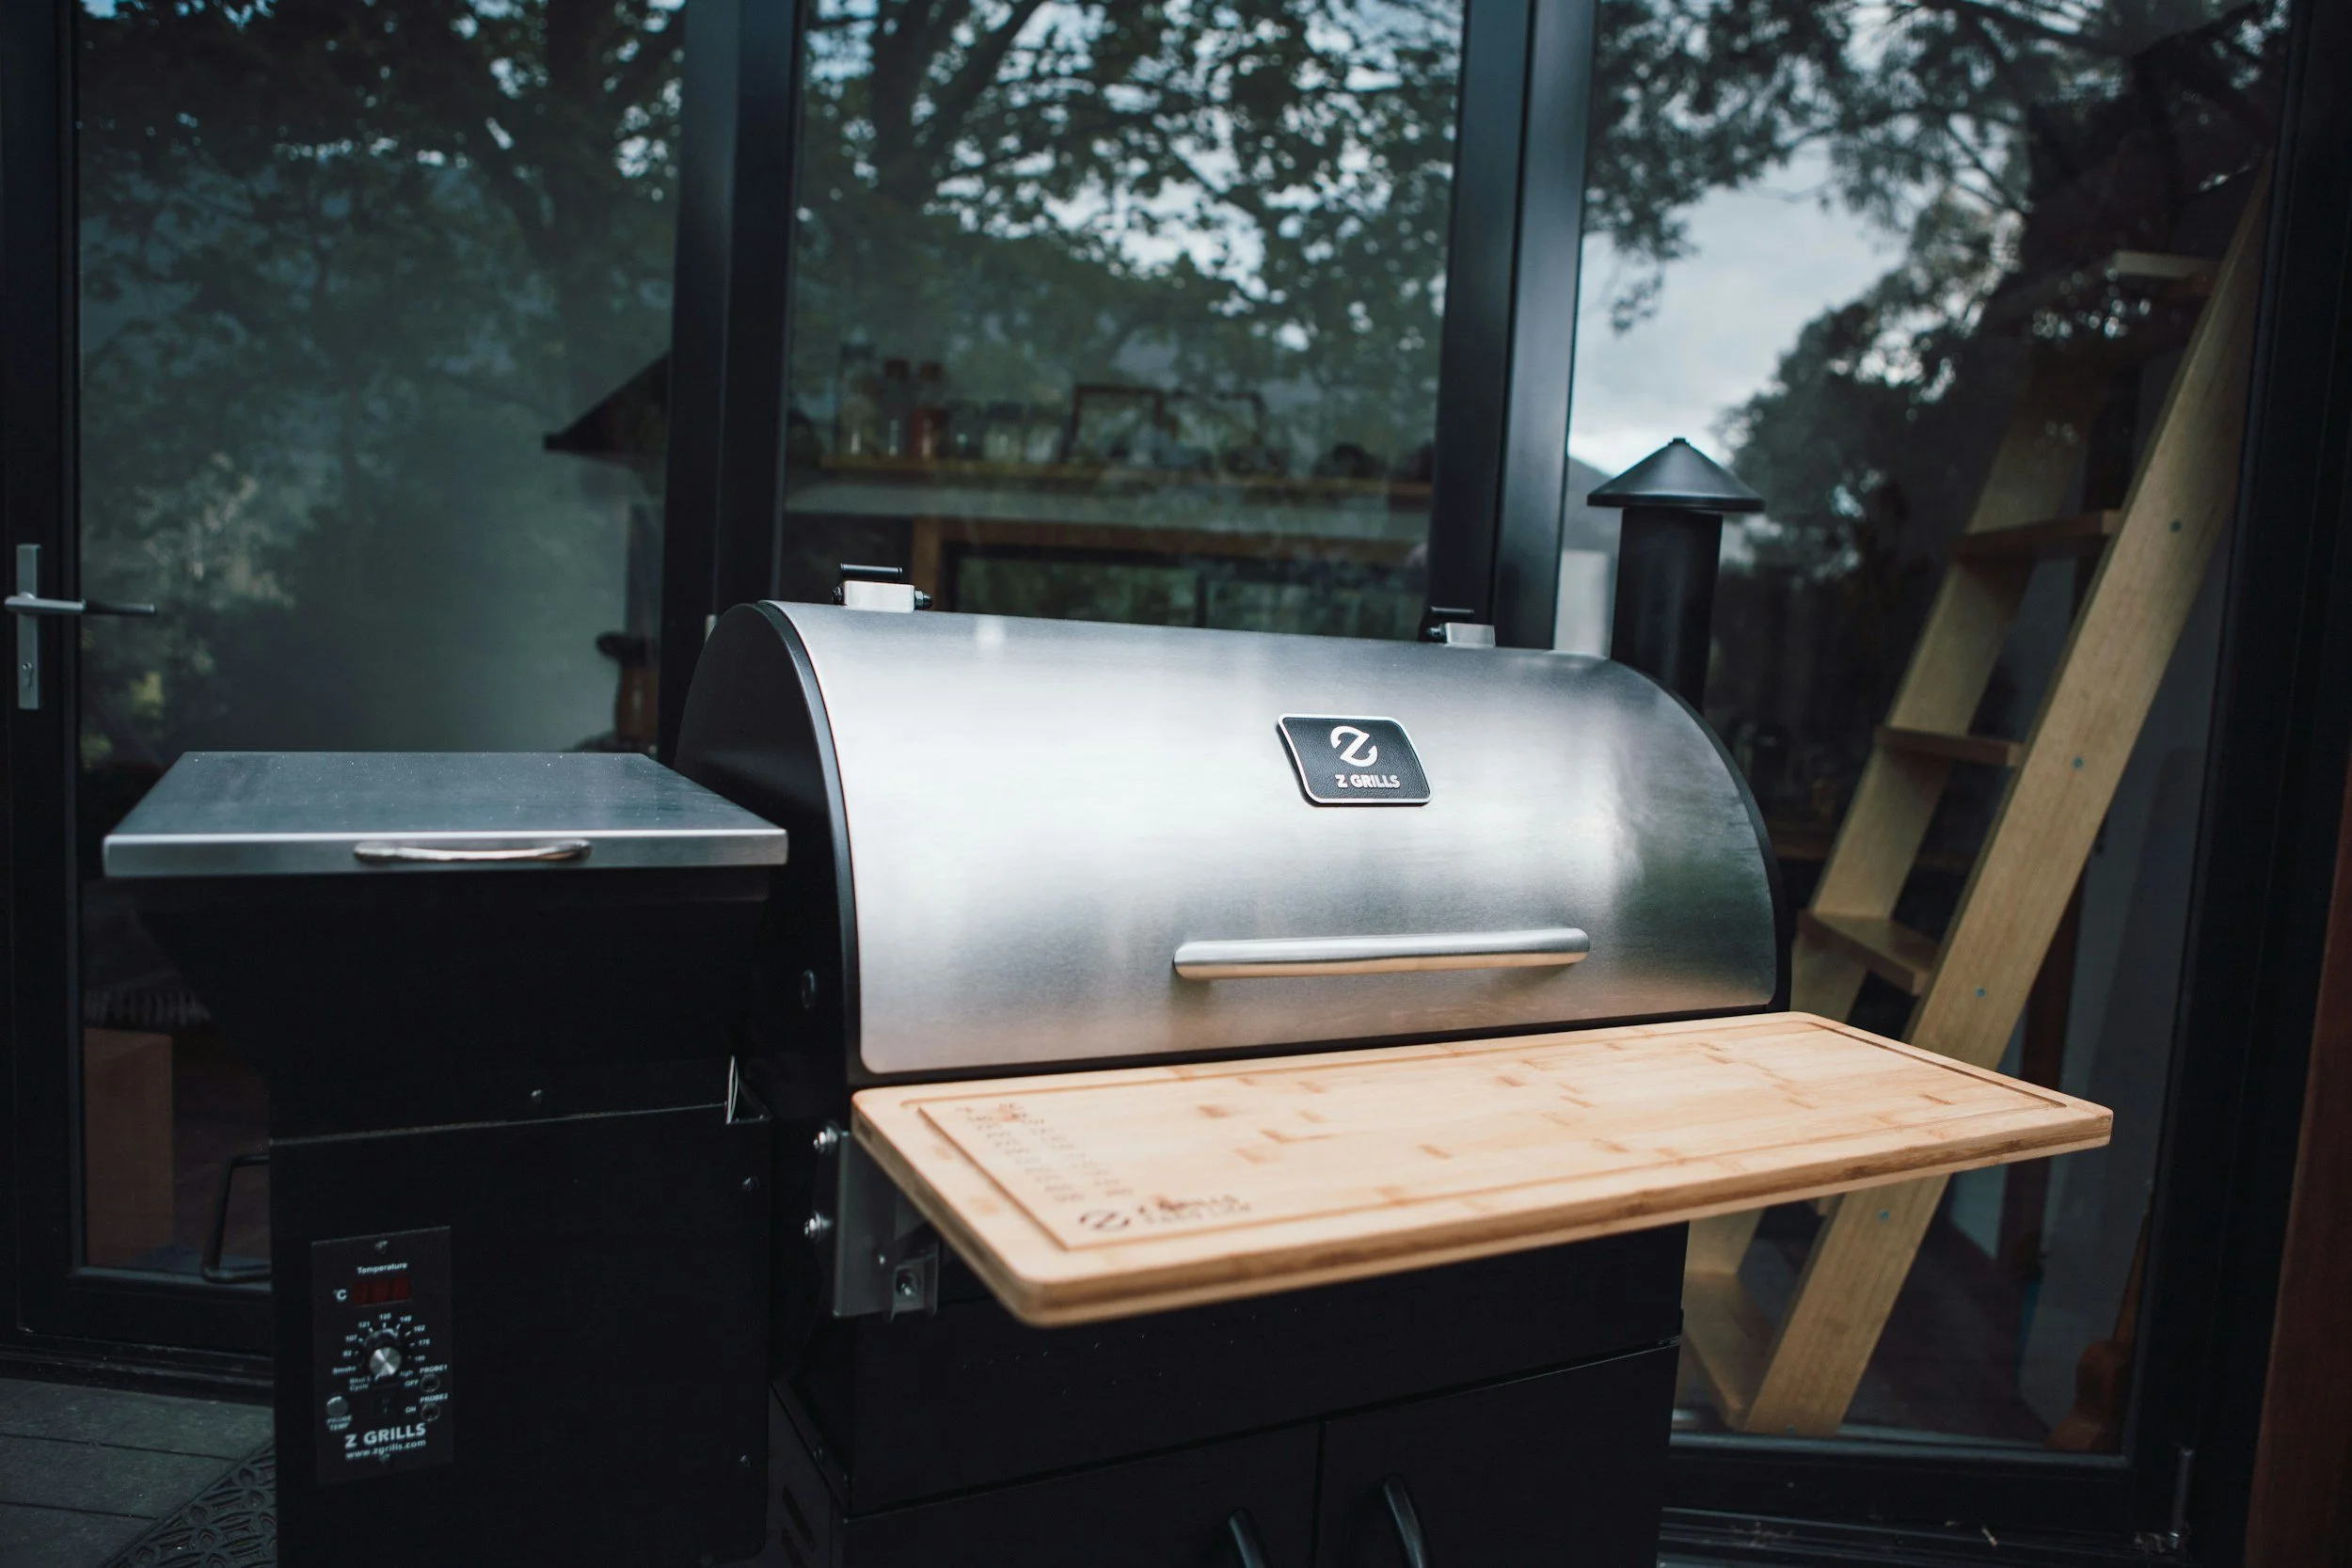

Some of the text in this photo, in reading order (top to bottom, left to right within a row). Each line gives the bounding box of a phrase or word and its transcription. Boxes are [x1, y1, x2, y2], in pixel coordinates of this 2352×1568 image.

[1335, 774, 1401, 789] Z GRILLS
[357, 1262, 408, 1275] Temperature
[420, 1364, 448, 1373] PROBE1
[405, 1379, 420, 1387] OFF
[405, 1405, 417, 1414] ON
[345, 1422, 427, 1449] Z GRILLS
[345, 1439, 427, 1460] www.zgrills.com
